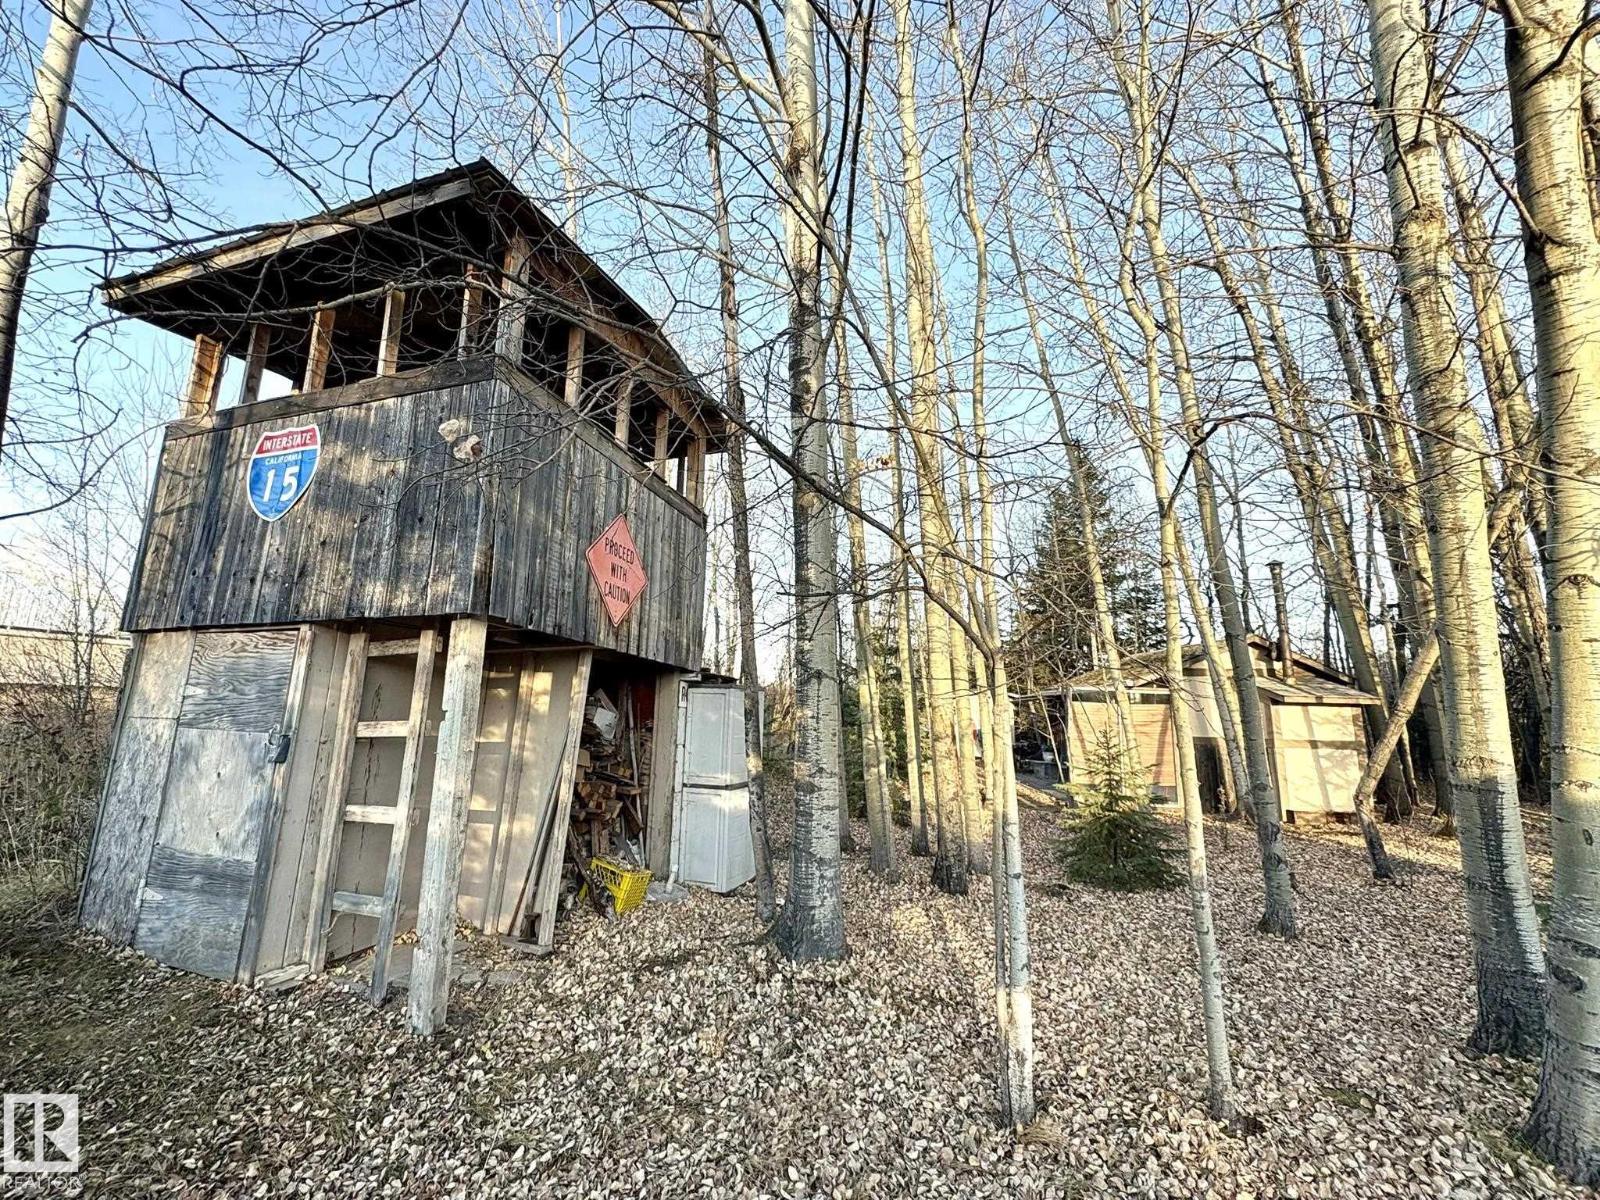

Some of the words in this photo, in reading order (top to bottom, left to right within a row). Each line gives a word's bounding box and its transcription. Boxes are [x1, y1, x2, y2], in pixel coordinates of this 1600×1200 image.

[262, 432, 313, 451] INTERSTATE
[265, 452, 302, 465] CALIFORNIA
[263, 465, 300, 502] 15
[604, 537, 635, 565] PROCEED
[611, 561, 628, 583] WITH
[604, 581, 631, 605] CAUTION
